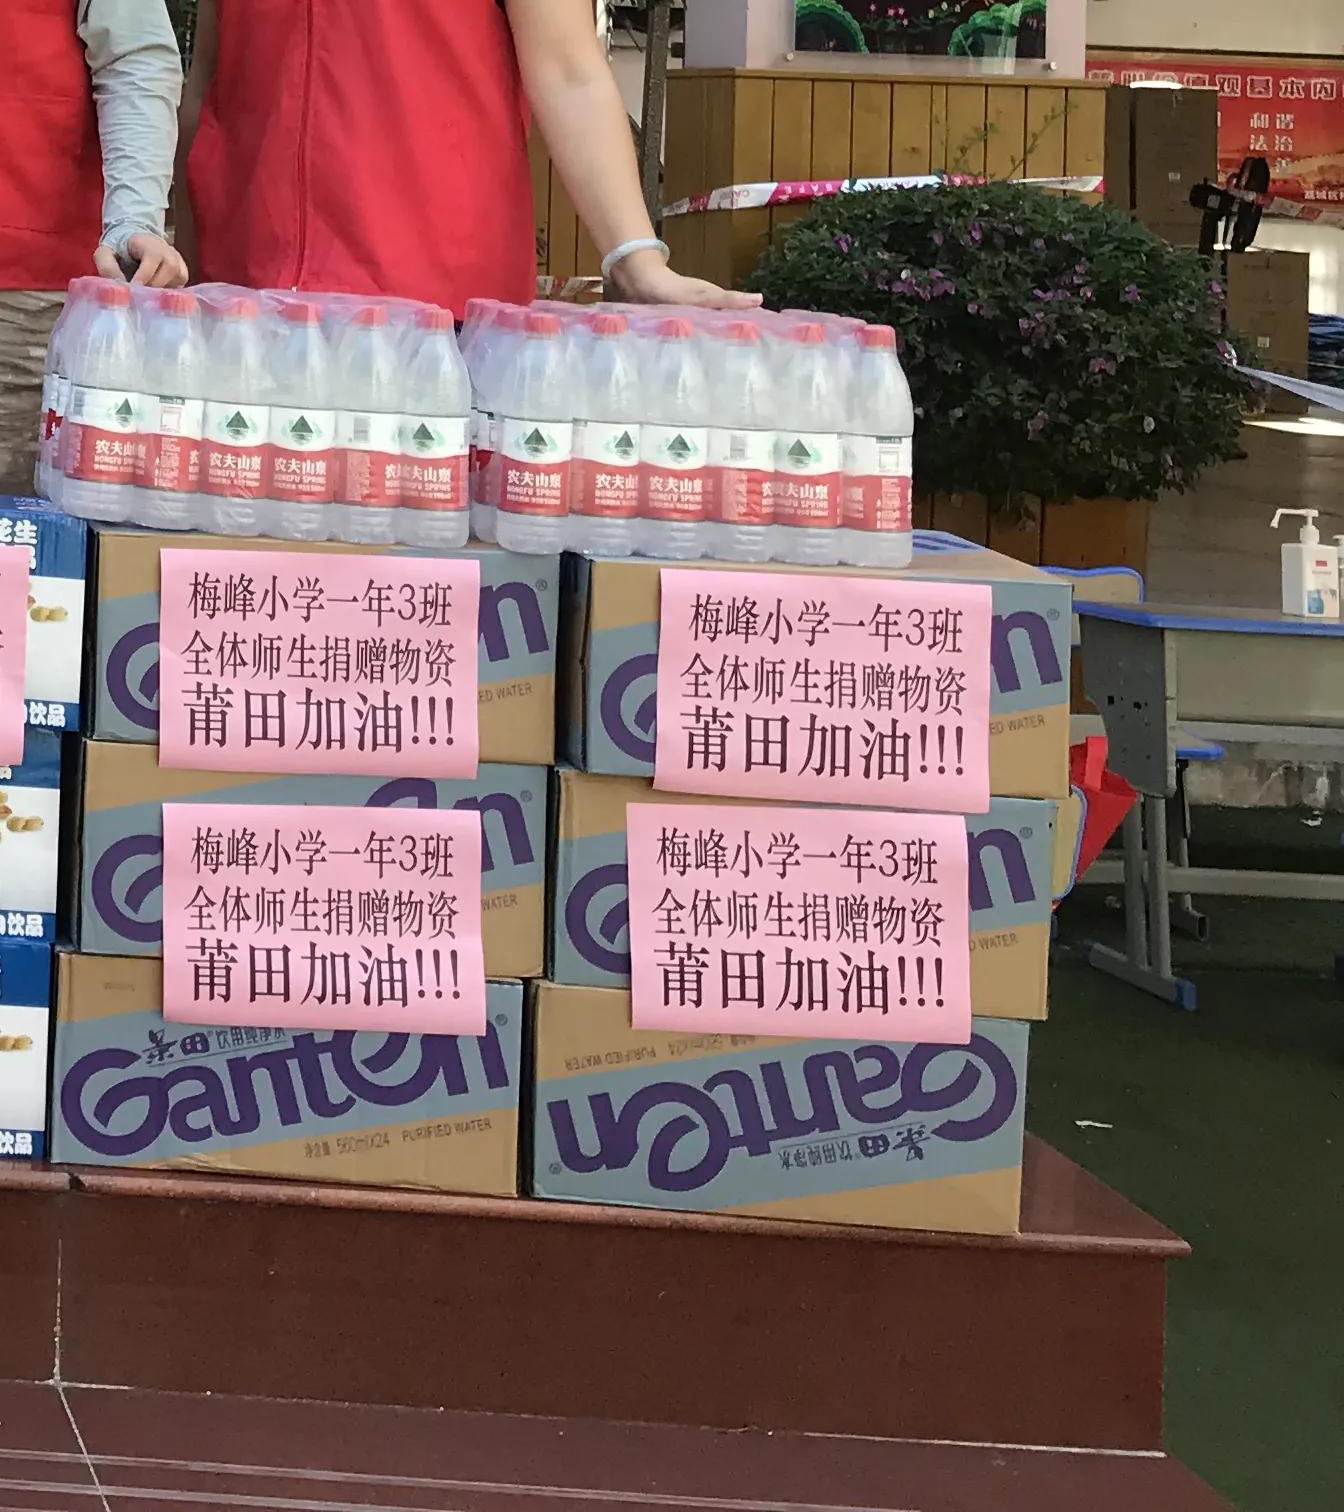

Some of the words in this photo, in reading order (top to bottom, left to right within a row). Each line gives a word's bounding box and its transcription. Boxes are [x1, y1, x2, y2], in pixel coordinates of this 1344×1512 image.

[189, 572, 452, 627] 梅峰小学一年3班
[689, 594, 963, 654] 梅峰小学一年3班
[182, 630, 456, 686] 全体师生捐赠物资
[681, 653, 966, 715] 全体师生捐赠物资
[182, 682, 453, 753] 莆田加油!!!
[681, 705, 963, 782] 莆田加油!!!
[191, 827, 453, 879] 梅峰小学一年3班
[657, 827, 937, 885] 梅峰小学一年3班
[185, 885, 458, 938] 全体师生捐赠物资
[652, 888, 944, 947] 全体师生捐赠物资
[186, 937, 460, 1007] 莆田加油!!!
[654, 941, 943, 1015] 莆田加油!!!
[564, 1052, 610, 1072] WATER
[610, 1045, 657, 1066] PURIFIED
[60, 1019, 510, 1156] Ganten
[547, 1033, 1018, 1192] Ganten
[402, 1122, 452, 1143] PURIFIED
[454, 1117, 492, 1135] WATER
